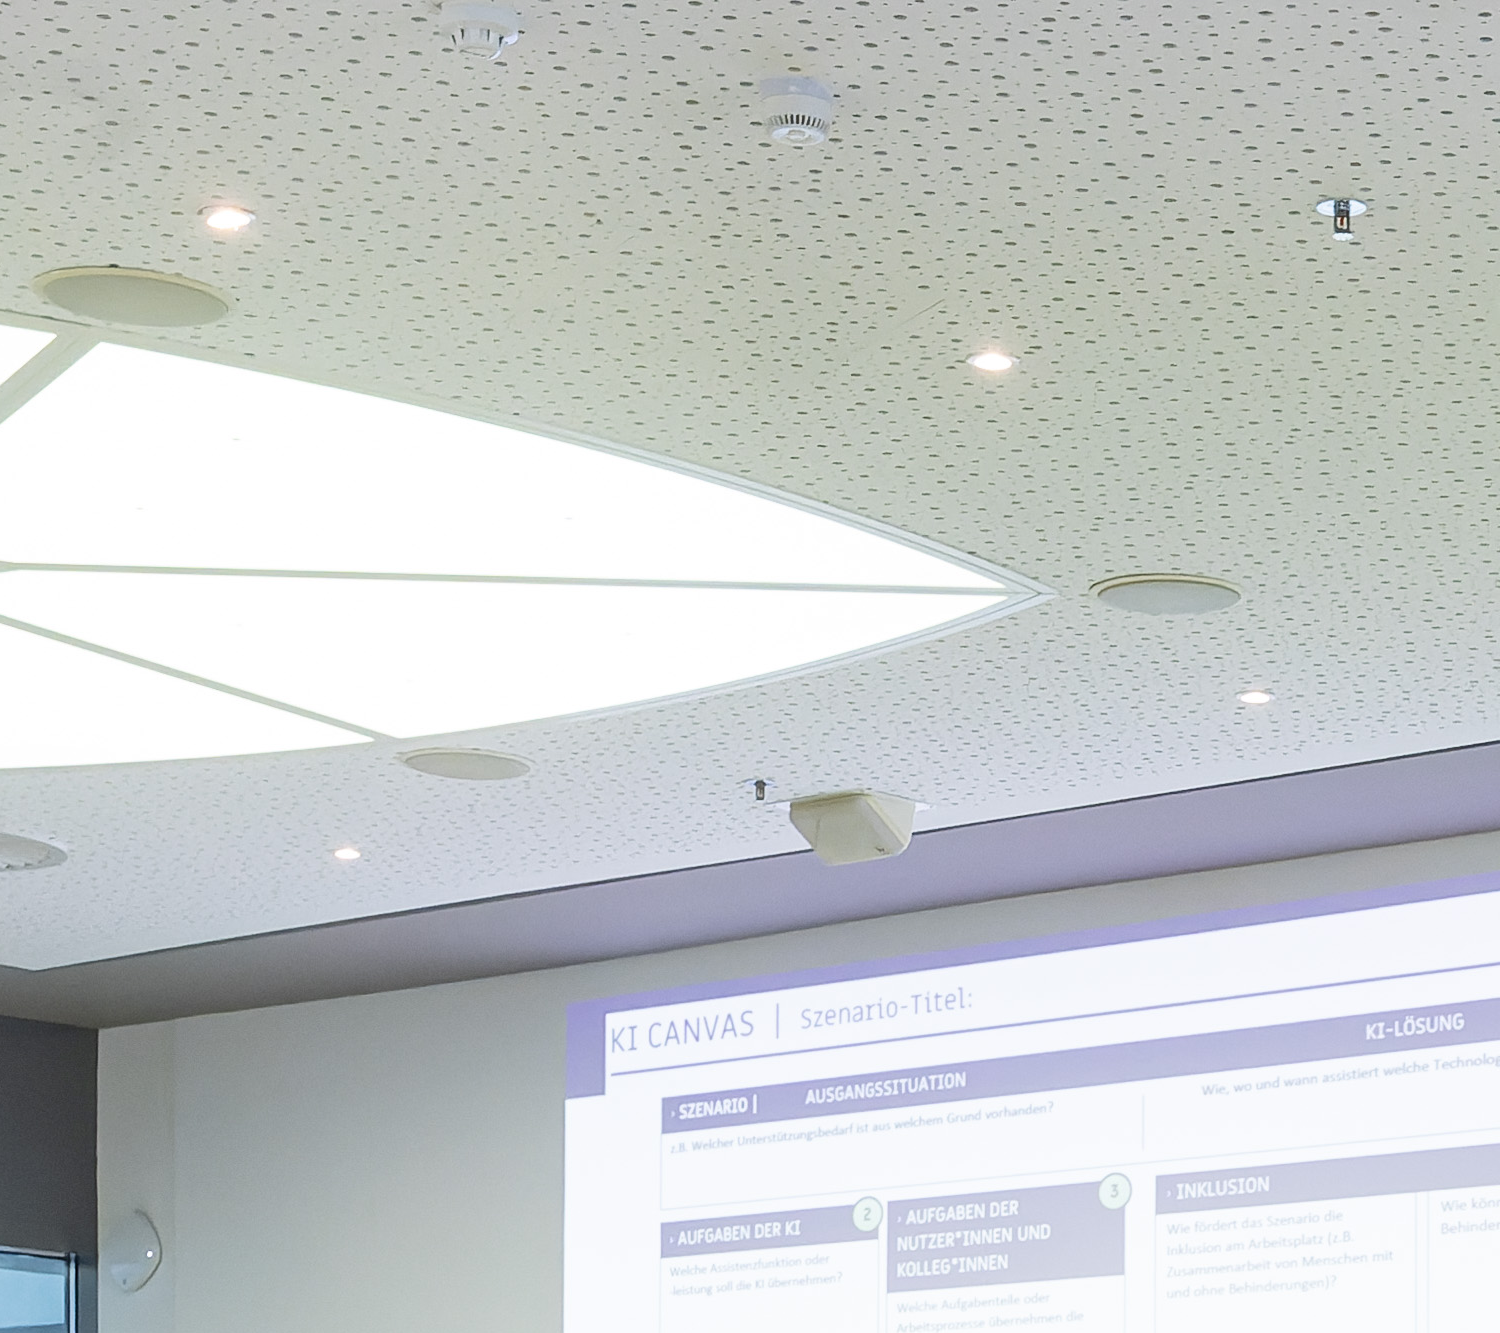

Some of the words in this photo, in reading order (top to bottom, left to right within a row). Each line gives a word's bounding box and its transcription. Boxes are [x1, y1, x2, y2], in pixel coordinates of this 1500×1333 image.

[610, 1024, 638, 1053] KI
[647, 1009, 755, 1048] CANVAS
[799, 986, 974, 1029] Szenario-Titel:
[1364, 1012, 1465, 1040] KI-LÖSUNG
[677, 1096, 749, 1120] SZENARIO
[803, 1071, 967, 1104] AUSGANGSSITUATION
[1110, 1183, 1119, 1199] 3
[1175, 1175, 1270, 1200] INKLUSION
[863, 1207, 872, 1222] 2
[904, 1202, 986, 1225] AUFGABEN
[988, 1198, 1020, 1218] DER
[676, 1224, 751, 1246] AUFGABEN
[753, 1221, 782, 1239] DER
[784, 1218, 802, 1236] KI
[1016, 1222, 1052, 1242] UND
